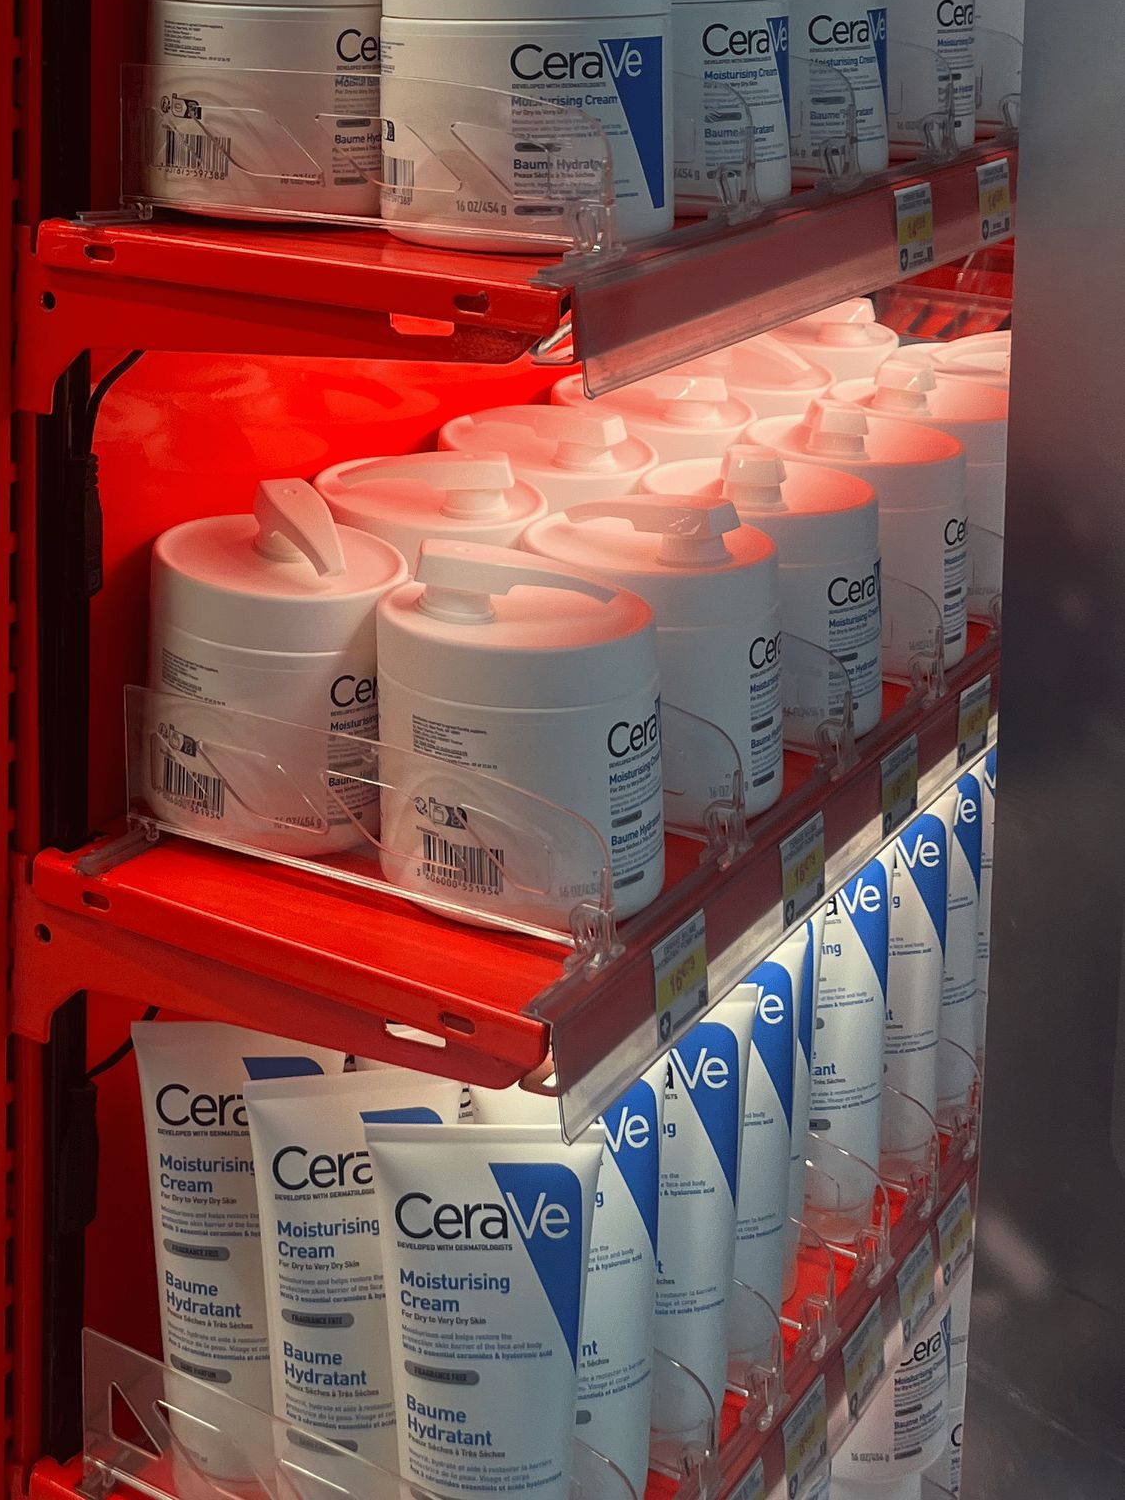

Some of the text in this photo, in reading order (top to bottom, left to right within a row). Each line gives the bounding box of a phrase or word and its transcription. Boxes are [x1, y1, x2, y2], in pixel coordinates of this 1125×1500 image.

[702, 16, 789, 56] CeraVe
[808, 14, 886, 46] CeraVe
[510, 41, 643, 81] CeraVe
[704, 68, 757, 81] Moisturising
[511, 94, 618, 108] Moisturising Cream
[335, 134, 365, 144] Baume
[456, 200, 466, 213] 16
[501, 204, 507, 216] g
[609, 763, 651, 785] Moisturising
[611, 828, 638, 846] Baume
[426, 873, 500, 896] 606000 551954
[160, 1173, 213, 1193] Cream
[395, 1191, 570, 1240] CeraVe
[277, 1217, 380, 1238] Moisturising
[278, 1241, 334, 1258] Cream
[397, 1241, 436, 1251] DEVELOPED
[437, 1243, 454, 1251] WITH
[165, 1270, 218, 1296] Baume
[399, 1268, 510, 1294] Moisturising
[166, 1289, 241, 1318] Hydratant
[400, 1291, 460, 1313] Cream
[402, 1309, 486, 1326] For Dry to Very Dry Skin
[283, 1341, 343, 1366] Baume
[284, 1361, 367, 1386] Hydratant
[406, 1393, 467, 1423] Baume
[407, 1414, 493, 1446] Hydratant
[428, 1440, 453, 1455] Sèches
[461, 1448, 477, 1458] Très
[479, 1449, 505, 1458] Sèches
